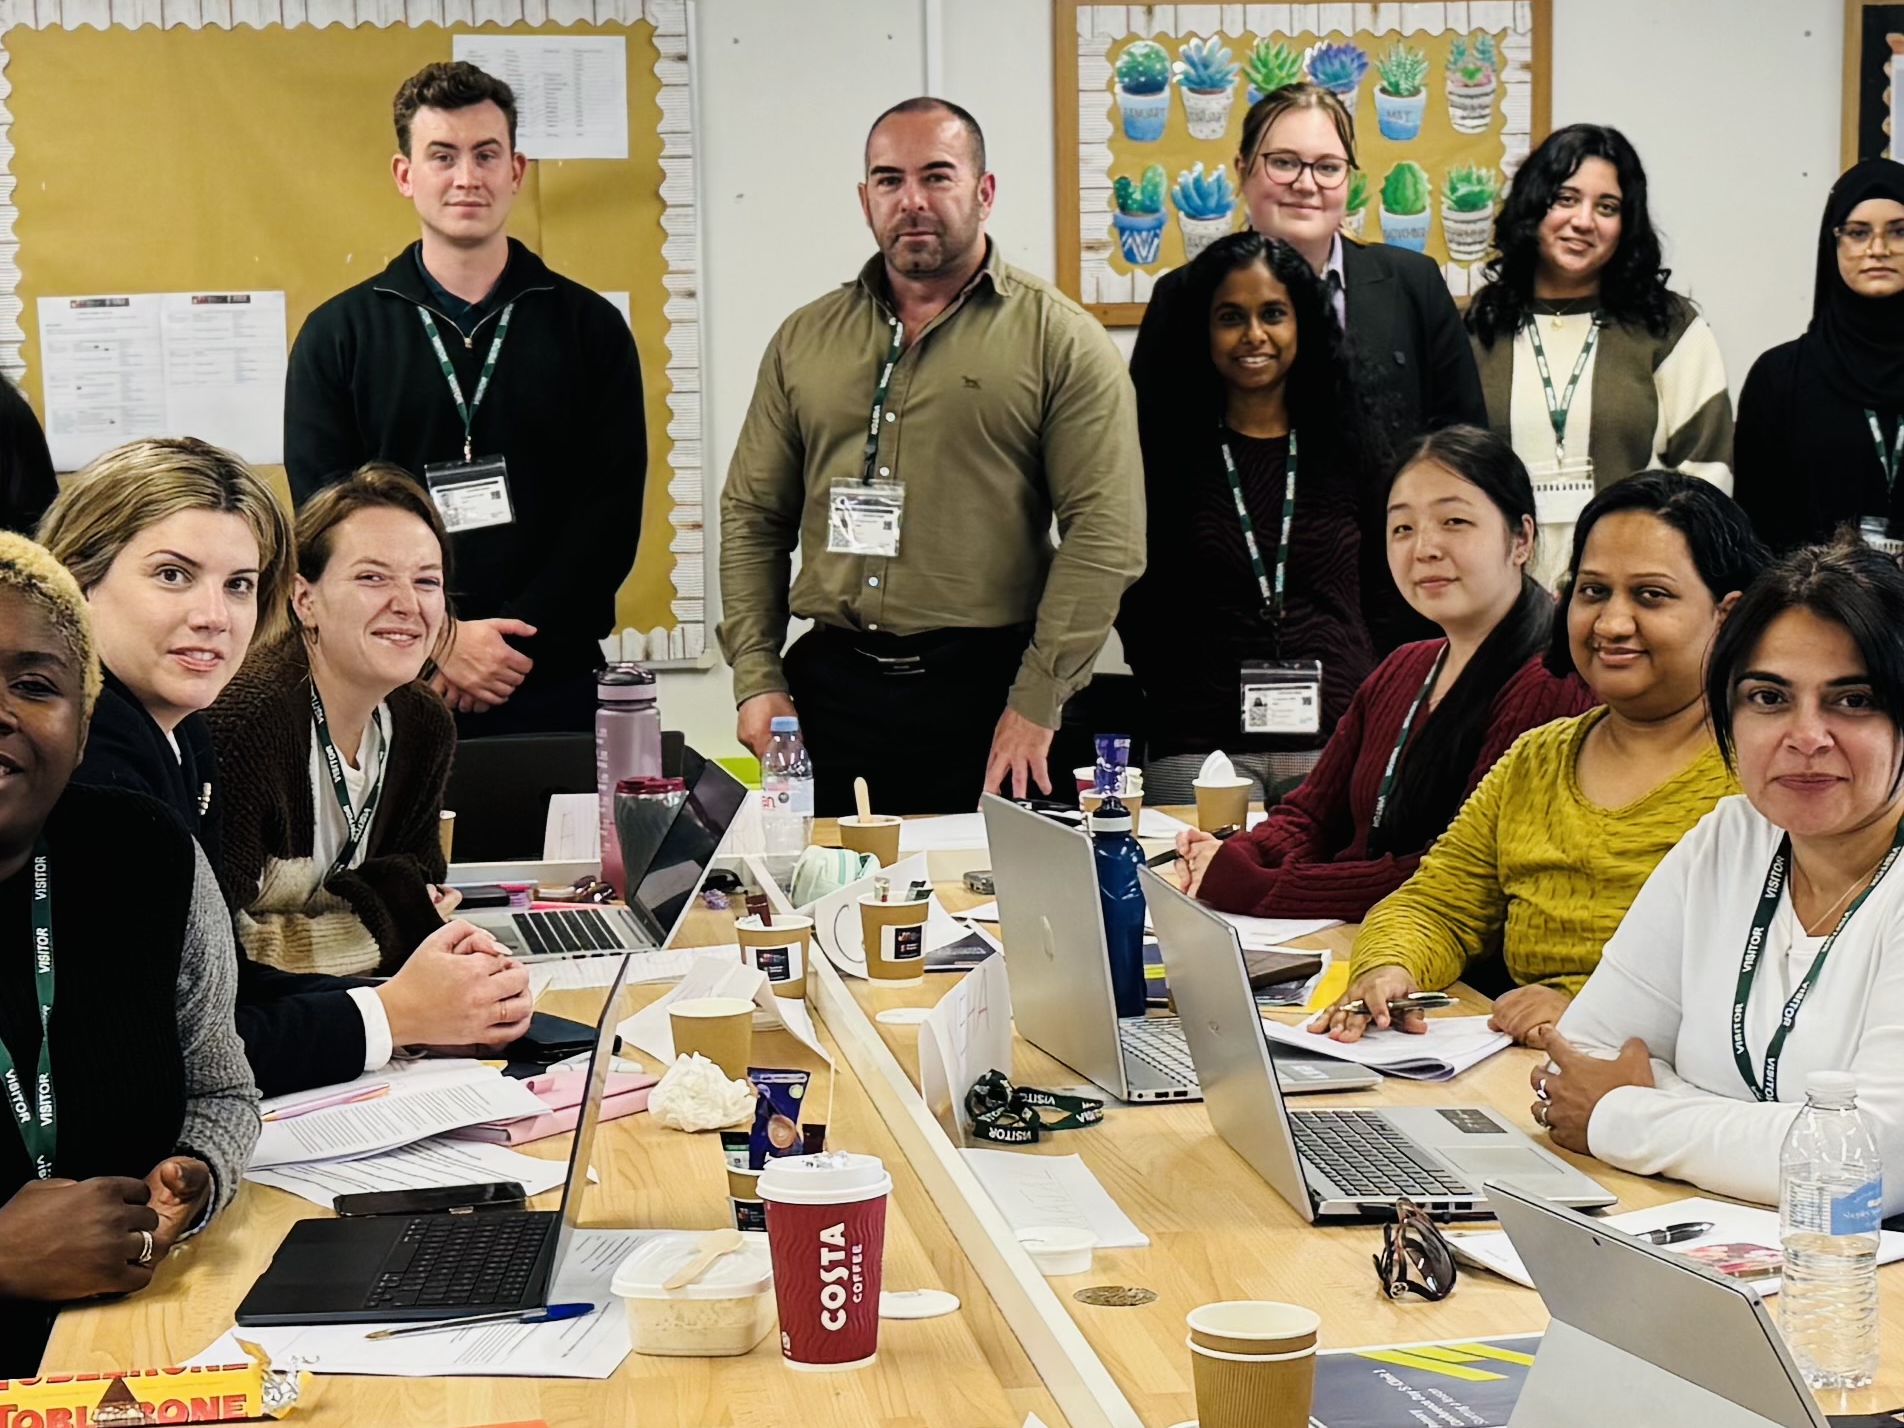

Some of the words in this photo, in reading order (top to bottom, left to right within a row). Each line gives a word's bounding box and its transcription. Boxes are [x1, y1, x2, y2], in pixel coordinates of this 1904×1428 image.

[35, 856, 47, 901] VISITOR
[1764, 854, 1785, 899] VISITOR
[38, 927, 51, 974] VISITOR
[1742, 926, 1764, 974] VISITOR
[1732, 1002, 1745, 1055] VISITOR
[5, 1068, 32, 1123] VISITOR
[39, 1072, 53, 1126] VISITOR
[1764, 1057, 1776, 1102] VISITO
[988, 1127, 1032, 1142] VISITOR
[820, 1222, 849, 1331] COSTA
[852, 1244, 863, 1304] COFFEE
